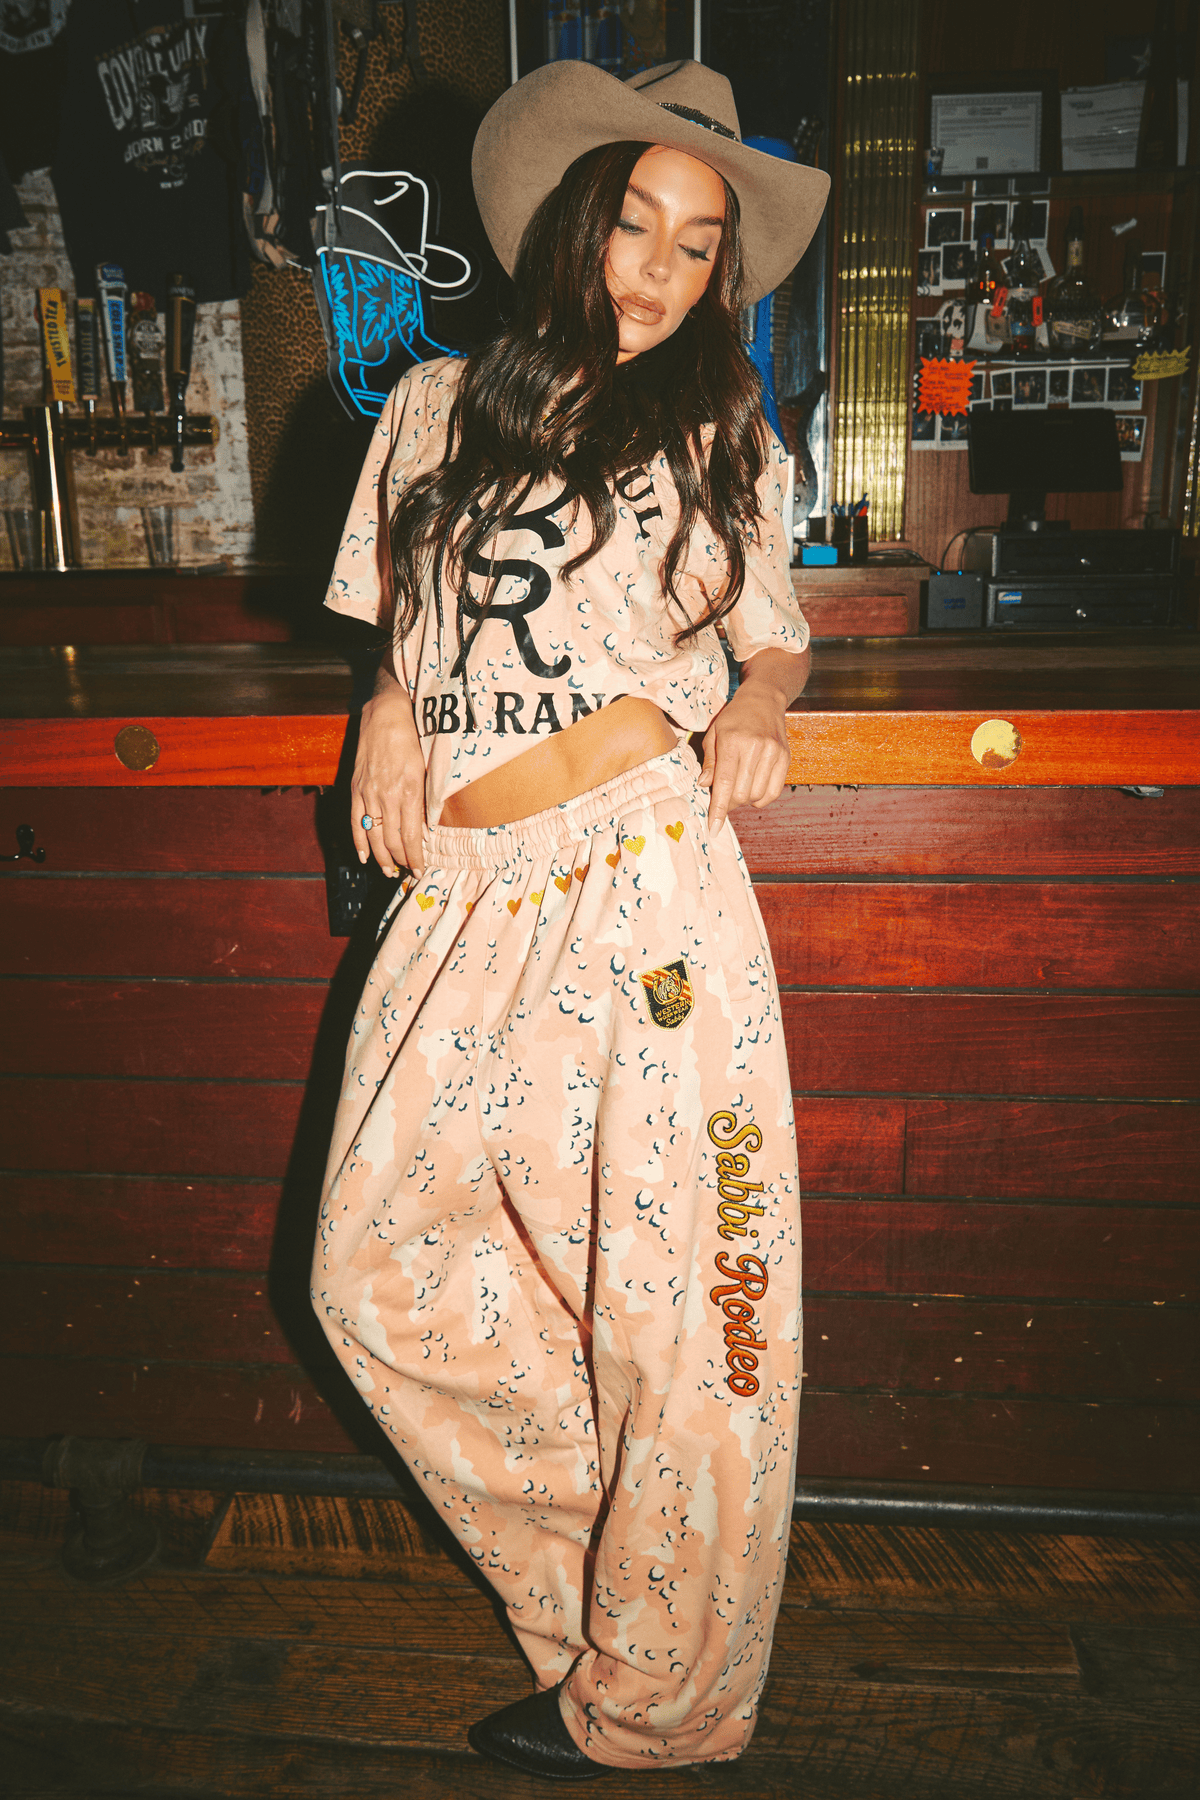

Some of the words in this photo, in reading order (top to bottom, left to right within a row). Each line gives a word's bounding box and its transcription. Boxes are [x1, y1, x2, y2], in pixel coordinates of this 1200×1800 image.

[81, 331, 94, 368] JUICY
[82, 372, 95, 394] IPA
[612, 465, 663, 539] UL
[418, 692, 478, 738] BBI
[493, 691, 629, 734] RAN
[707, 1110, 765, 1241] Sabbi
[709, 1251, 768, 1397] Rodeo
